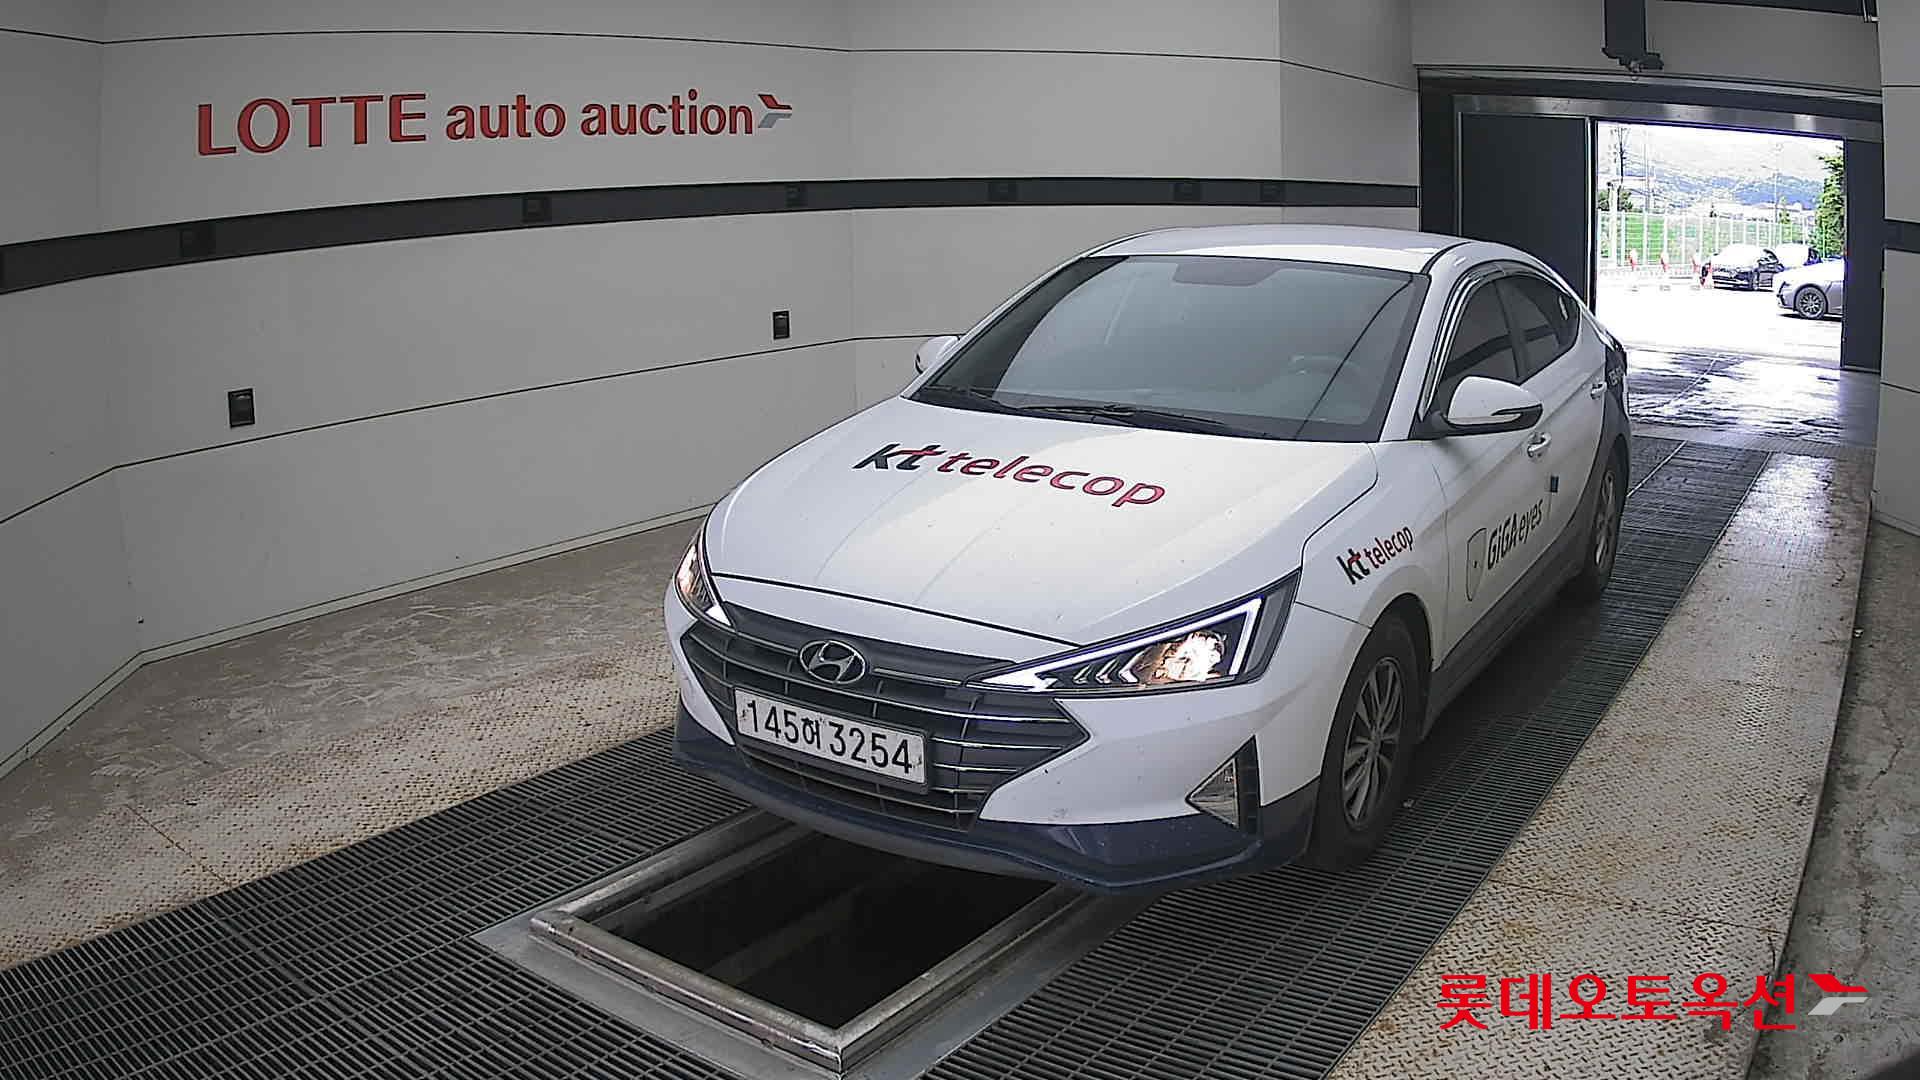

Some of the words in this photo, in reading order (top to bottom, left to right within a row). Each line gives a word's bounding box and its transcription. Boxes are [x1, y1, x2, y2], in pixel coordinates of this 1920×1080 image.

[198, 92, 427, 156] LOTTE
[445, 93, 567, 141] auto
[580, 88, 754, 136] auction
[852, 443, 946, 470] kt
[937, 451, 1166, 508] telecop
[1518, 498, 1543, 544] eyes
[1336, 548, 1370, 585] kt
[1366, 526, 1414, 569] telecop
[828, 720, 913, 775] 3254
